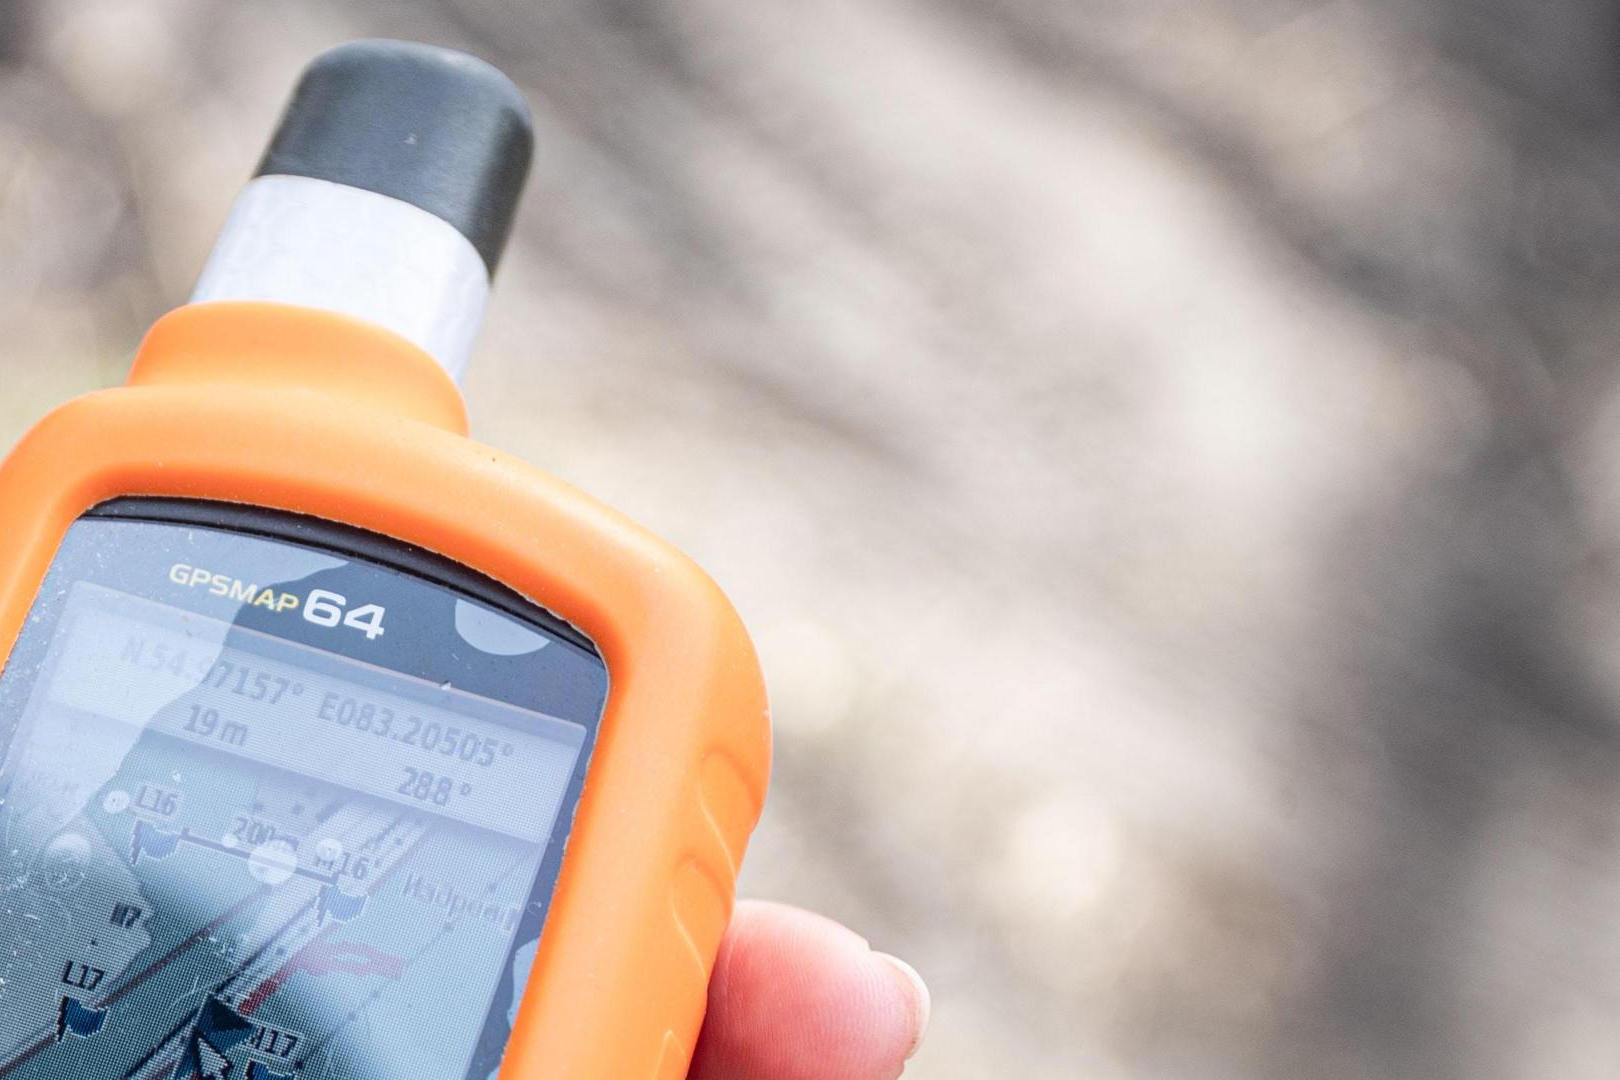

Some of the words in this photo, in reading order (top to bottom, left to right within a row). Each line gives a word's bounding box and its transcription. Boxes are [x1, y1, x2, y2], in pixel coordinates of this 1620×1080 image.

[169, 563, 300, 612] GPSMAP
[303, 588, 385, 640] 64
[135, 785, 178, 816] L16
[62, 961, 104, 991] L17
